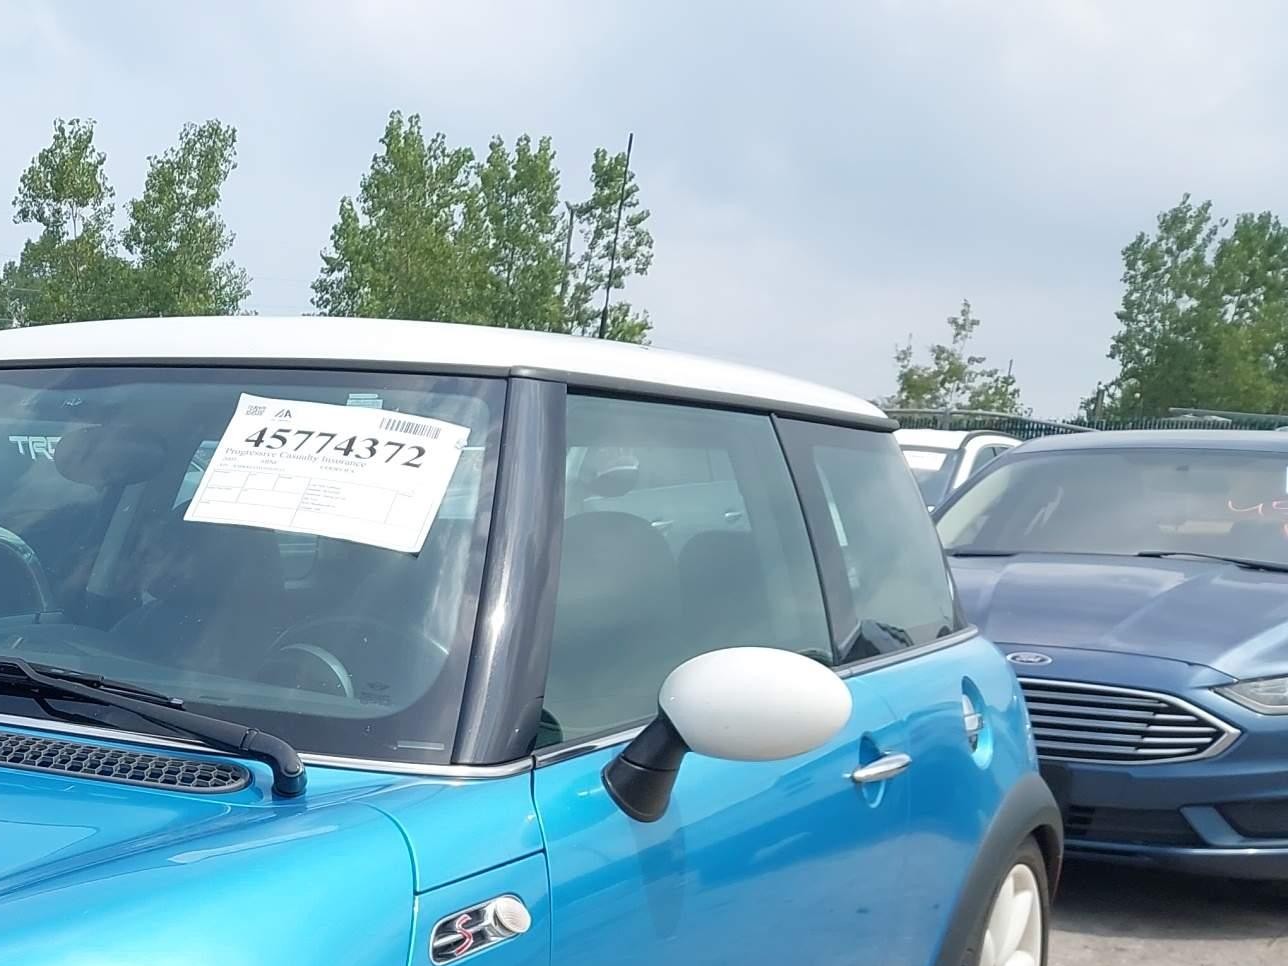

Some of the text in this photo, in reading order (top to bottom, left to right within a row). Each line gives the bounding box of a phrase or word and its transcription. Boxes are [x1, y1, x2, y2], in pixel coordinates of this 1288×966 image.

[225, 447, 276, 459] Progressive
[279, 451, 319, 463] Casualty
[321, 455, 368, 468] Insurance
[244, 426, 426, 469] 45774372
